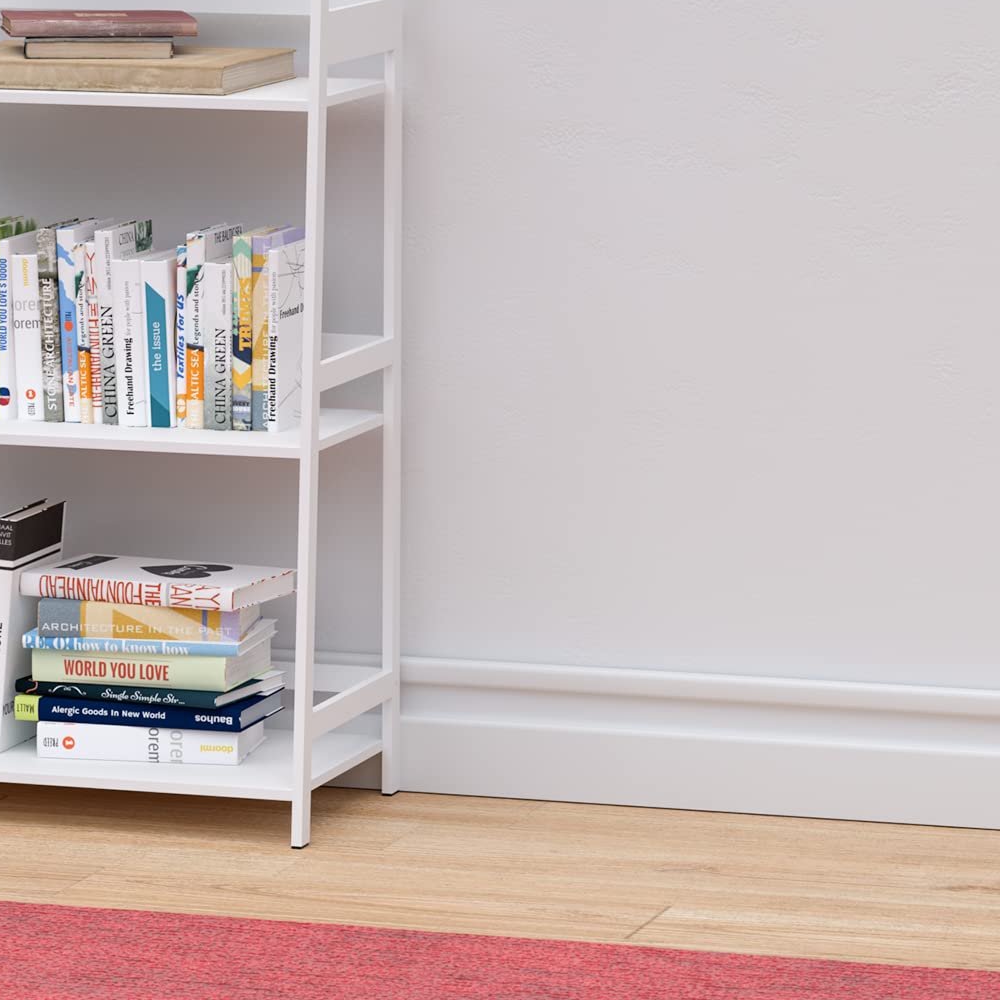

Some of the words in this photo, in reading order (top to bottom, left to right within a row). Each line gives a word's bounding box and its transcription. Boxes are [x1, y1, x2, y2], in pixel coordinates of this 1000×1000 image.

[0, 290, 7, 307] LOVE
[0, 308, 7, 324] YOU
[42, 278, 56, 367] ARCHITECTURE
[176, 313, 185, 331] for
[0, 325, 7, 351] WORLD
[100, 306, 115, 359] GREEN
[192, 314, 201, 345] Legends
[124, 337, 134, 373] Drawing
[151, 353, 162, 372] the
[191, 349, 200, 368] SEA
[214, 328, 226, 374] GREEN
[268, 336, 278, 375] Drawing
[103, 364, 117, 418] CHINA
[125, 375, 135, 415] Freehand
[214, 378, 226, 424] CHINA
[268, 378, 277, 422] Freehand
[39, 574, 143, 605] FOUNTAINHEAD
[145, 582, 162, 606] THE
[41, 622, 144, 634] ARCHITECTURE
[73, 637, 100, 651] how
[104, 640, 118, 652] to
[121, 640, 158, 655] know
[161, 641, 191, 656] how
[63, 659, 107, 678] WORLD
[110, 661, 136, 679] YOU
[139, 663, 169, 681] LOVE
[101, 688, 129, 701] Single
[130, 690, 162, 704] Simple
[51, 706, 80, 717] Alergic
[81, 706, 108, 717] Goods
[110, 708, 119, 717] In
[121, 709, 140, 718] New
[142, 710, 166, 720] World
[194, 713, 233, 726] Bauhos
